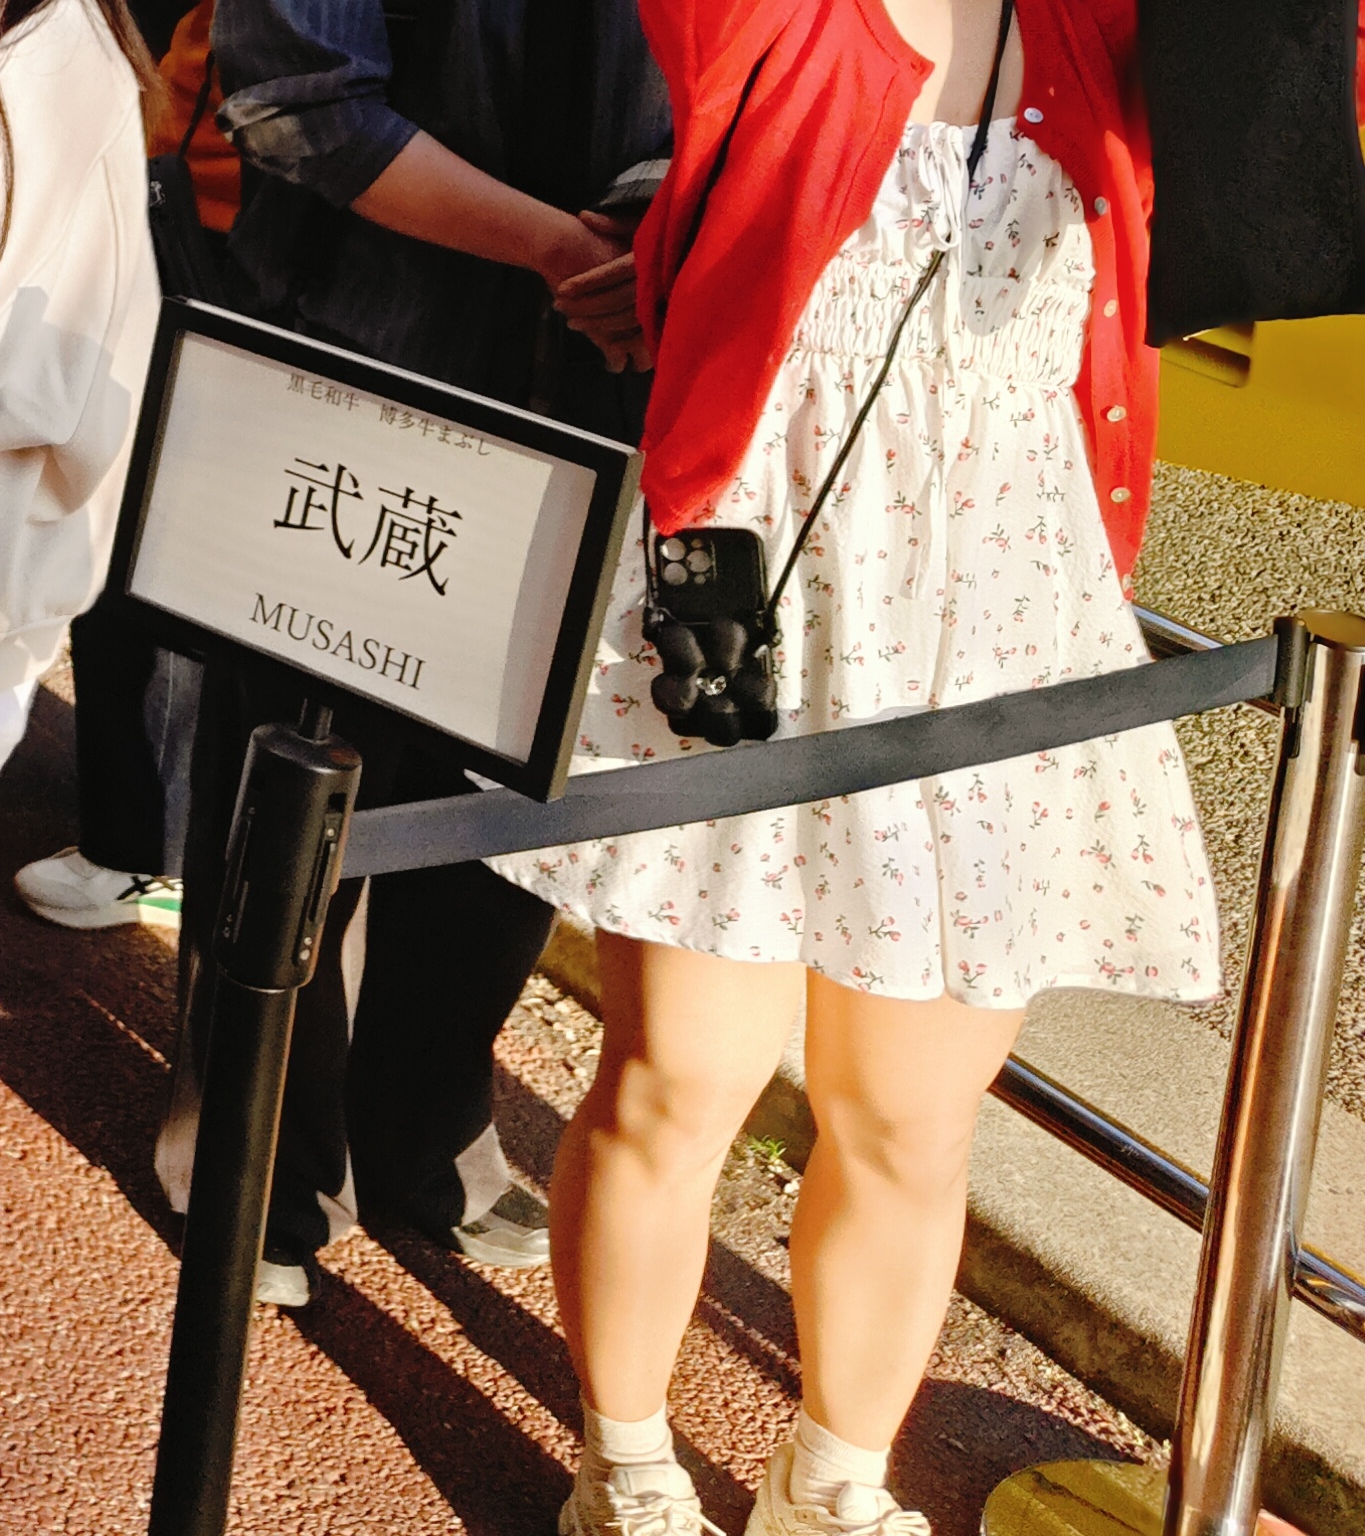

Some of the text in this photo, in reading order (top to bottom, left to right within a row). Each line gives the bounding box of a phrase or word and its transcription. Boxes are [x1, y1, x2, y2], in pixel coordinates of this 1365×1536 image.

[287, 372, 491, 456] 黒毛和牛 博多牛まぶし
[273, 456, 464, 597] 武蔵
[249, 592, 427, 691] MUSASHI
